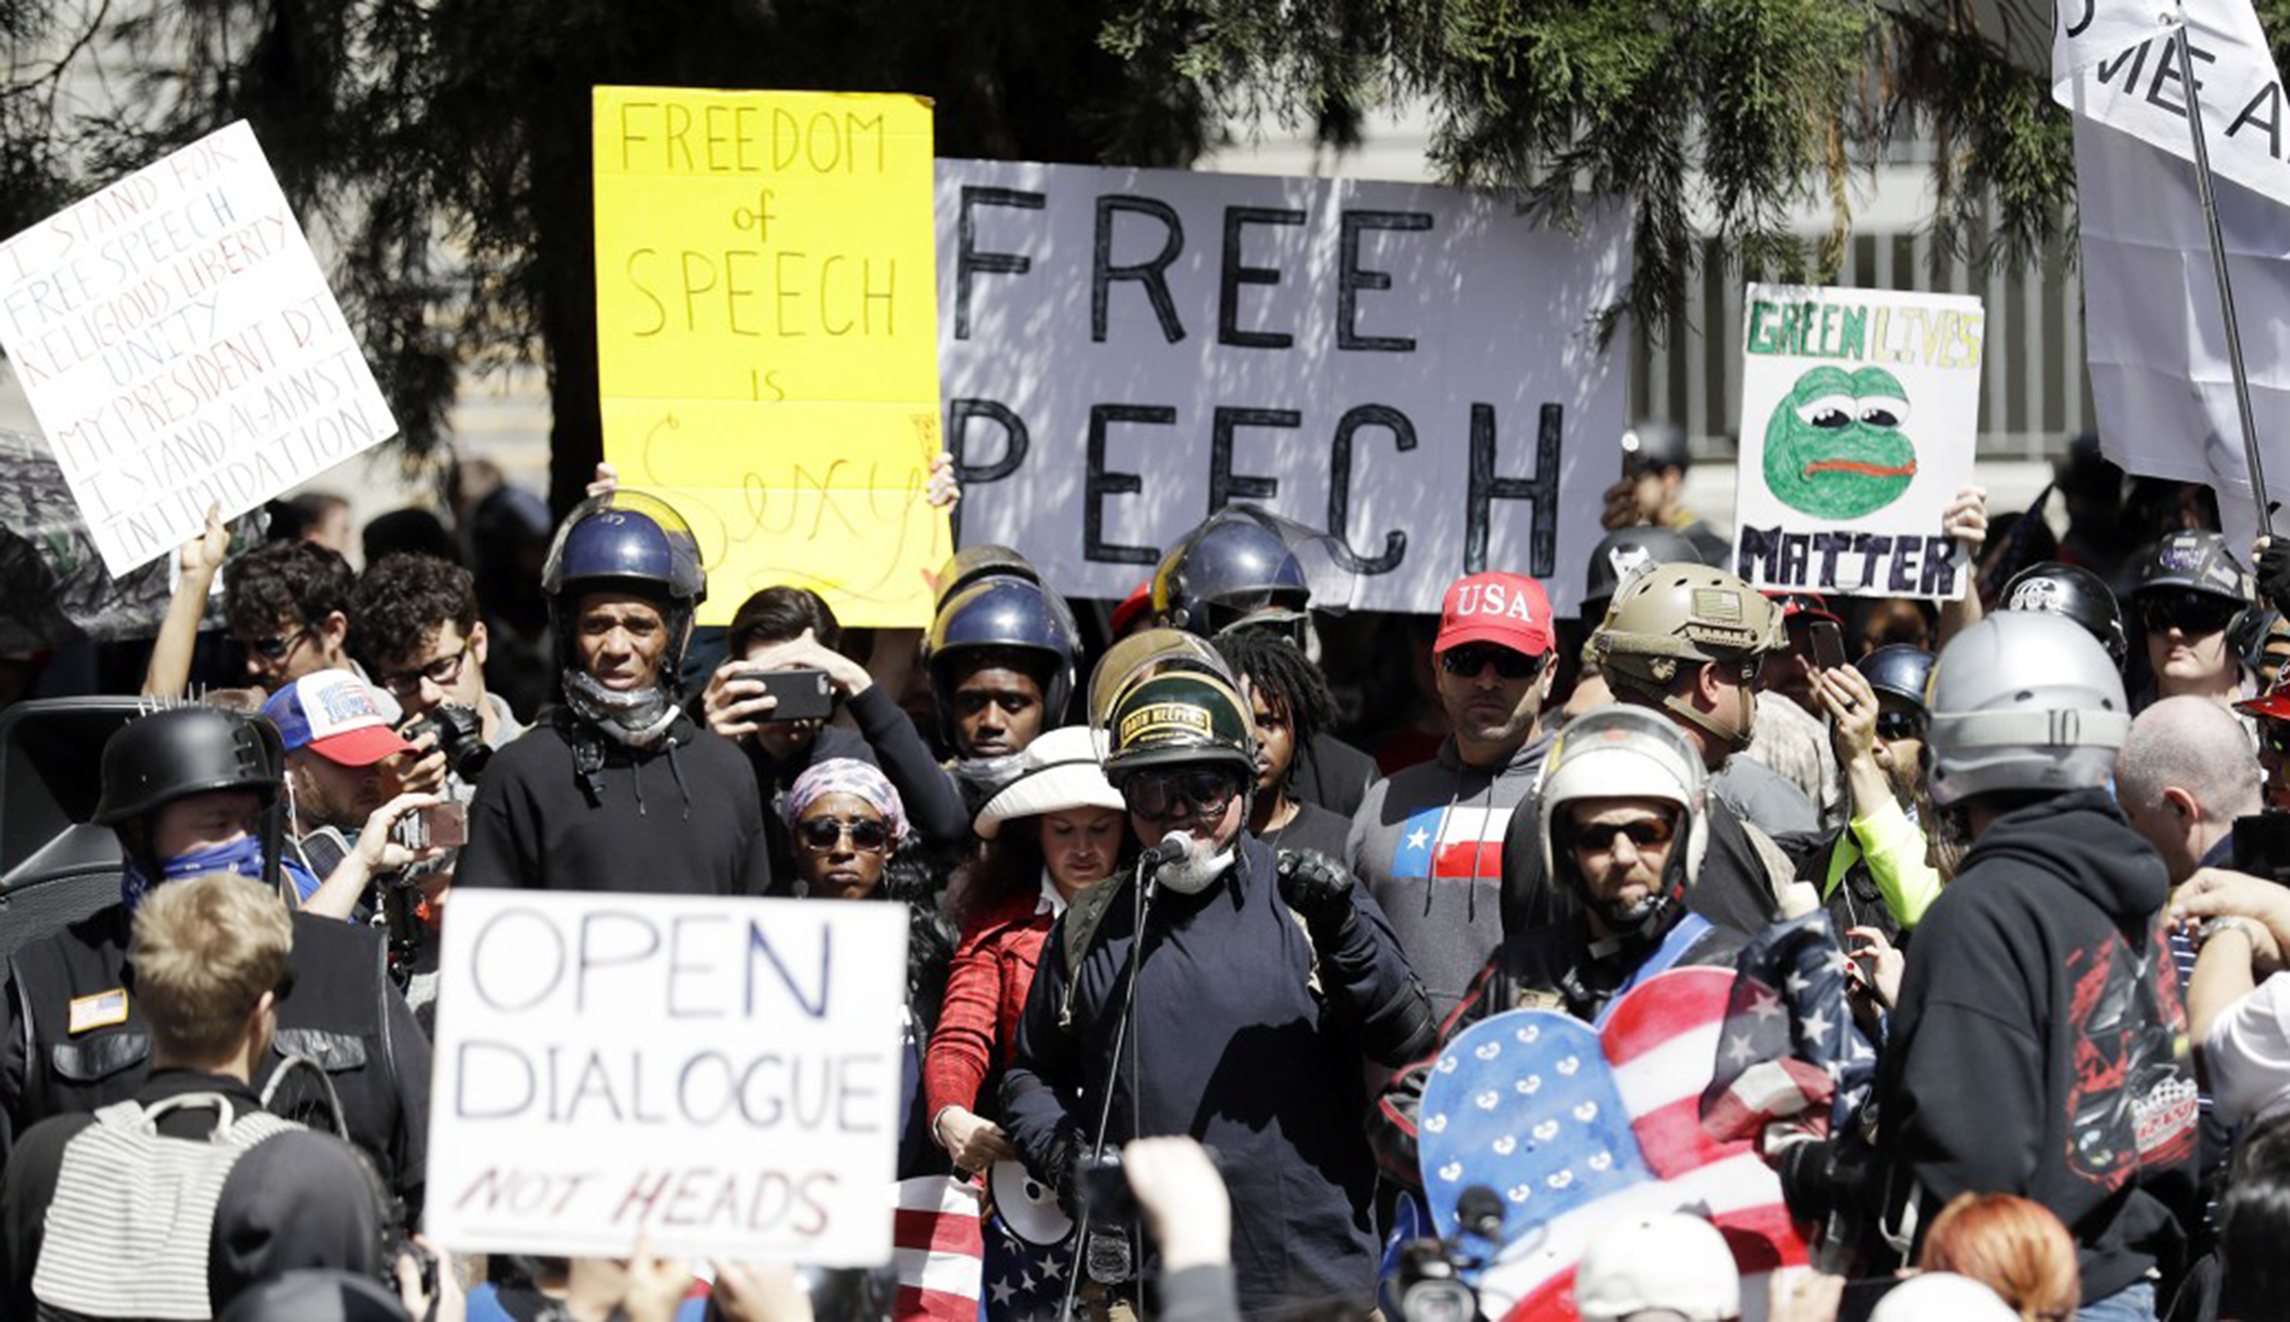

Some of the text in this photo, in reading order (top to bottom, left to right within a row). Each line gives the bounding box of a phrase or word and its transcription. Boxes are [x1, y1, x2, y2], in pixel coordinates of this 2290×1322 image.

[620, 102, 884, 173] FREEDOM
[2224, 80, 2290, 164] A
[2, 133, 238, 285] I STAND FOR
[733, 188, 777, 243] of
[3, 186, 238, 337] FREE SPEECH
[14, 207, 289, 388] RELIGIOUS LIBERTY
[626, 249, 895, 336] SPEECH
[955, 185, 1434, 351] FREE
[103, 290, 220, 387] UNITY
[1747, 299, 1982, 369] GREEN LIVES
[57, 405, 115, 472] MY
[112, 320, 278, 455] PRESIDENT
[752, 369, 785, 404] IS
[79, 347, 364, 525] I STAND AGAINST
[947, 398, 1563, 578] PEECH
[1456, 583, 1533, 623] USA
[1738, 524, 1957, 595] MATTER
[470, 907, 832, 1019] OPEN
[455, 1039, 884, 1134] DIALOGUE
[454, 1166, 839, 1238] NOT HEADS
